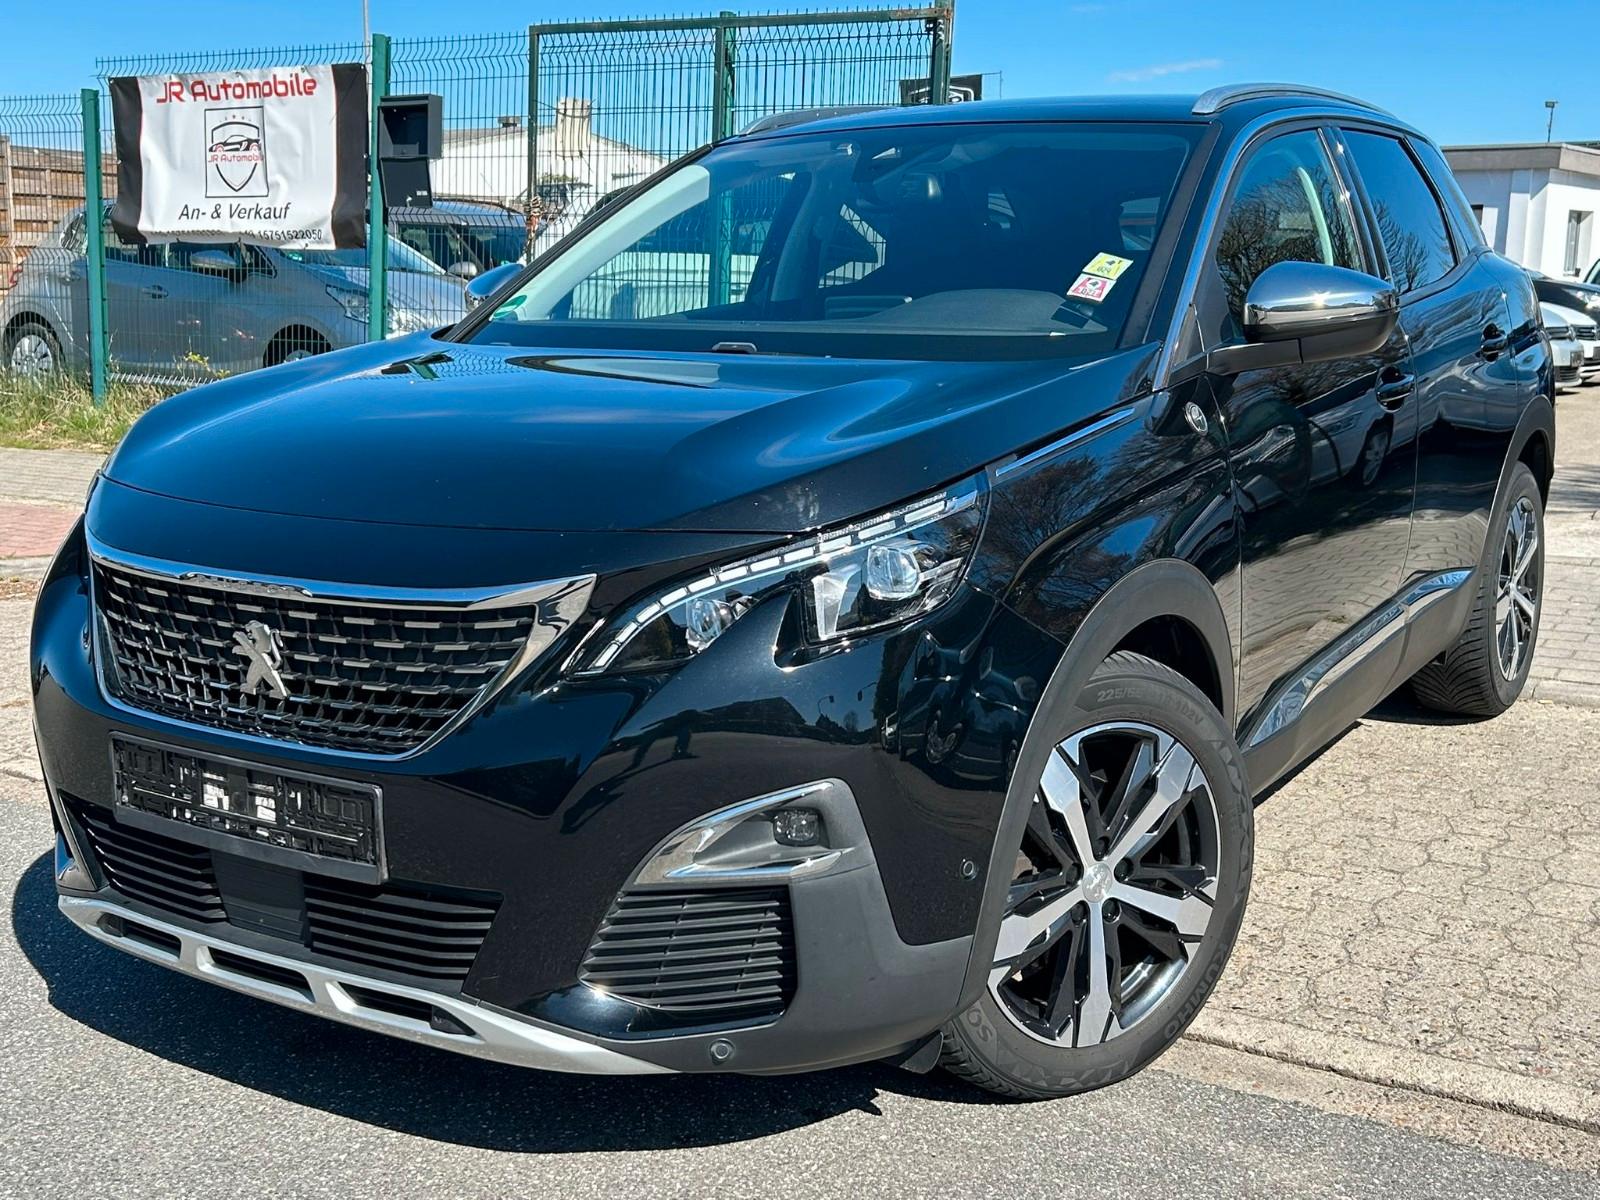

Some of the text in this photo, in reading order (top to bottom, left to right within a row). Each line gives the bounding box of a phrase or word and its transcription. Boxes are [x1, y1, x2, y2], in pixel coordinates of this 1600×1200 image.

[156, 73, 317, 104] JR Automobile
[208, 154, 219, 163] JR
[178, 202, 292, 221] An- & Verkauf
